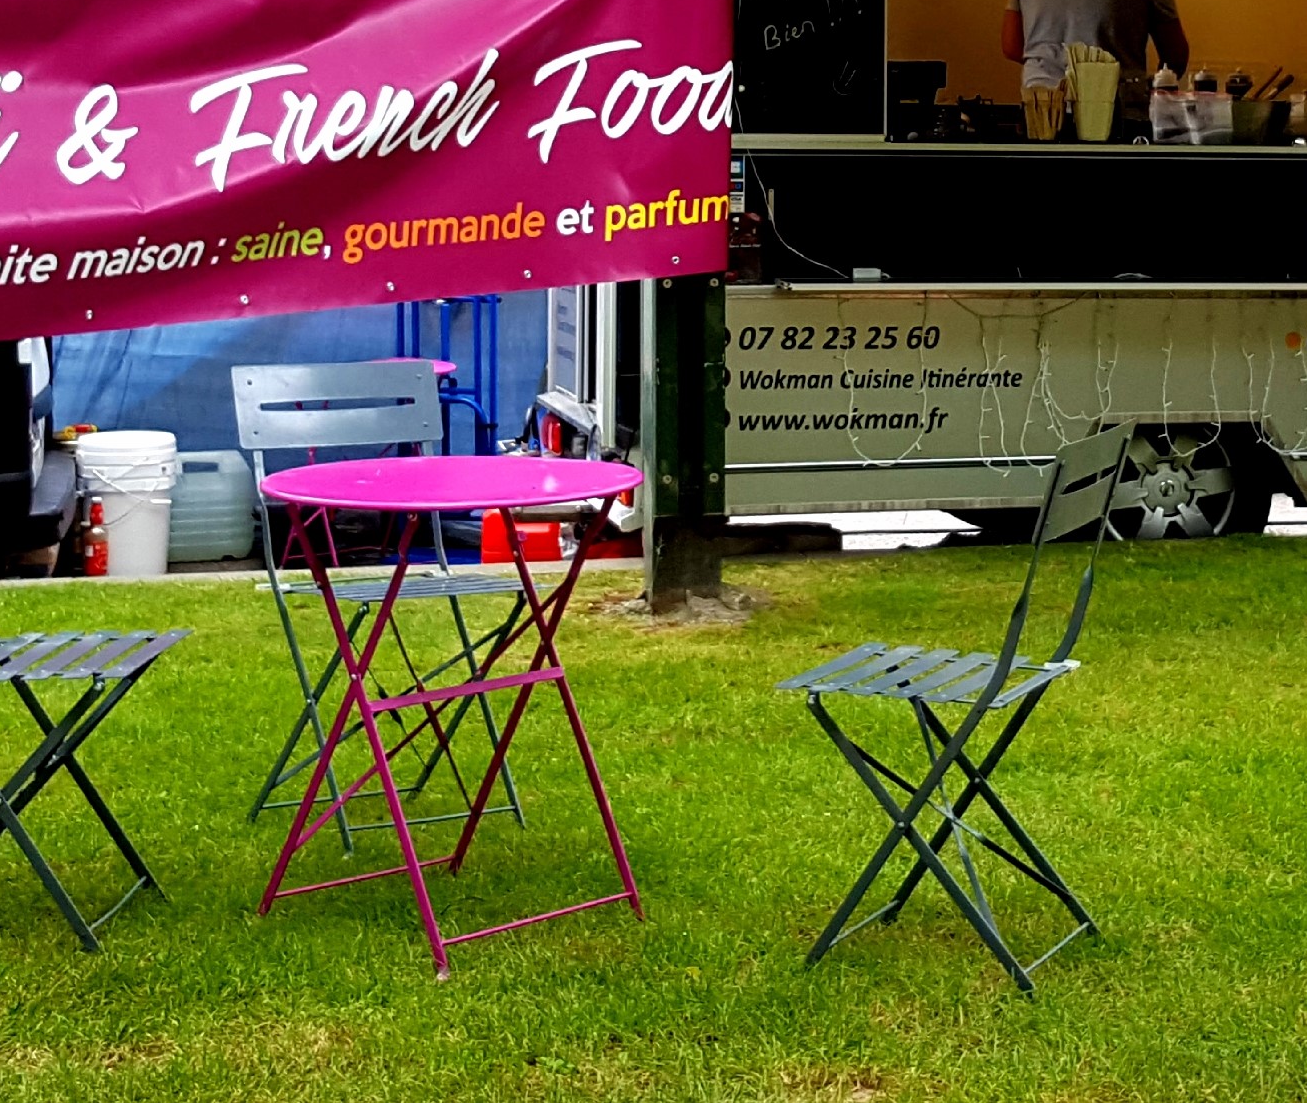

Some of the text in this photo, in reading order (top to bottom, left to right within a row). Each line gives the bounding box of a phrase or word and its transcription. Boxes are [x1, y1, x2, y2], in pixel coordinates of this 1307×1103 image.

[56, 84, 139, 186] &
[190, 48, 500, 193] French
[79, 239, 204, 280] maison
[231, 221, 332, 264] saine,
[342, 202, 546, 265] gourmande
[555, 201, 595, 235] et
[738, 325, 941, 350] 07 82 23 25 60
[739, 367, 1023, 390] Wokman Cuisine Itinérante
[738, 407, 949, 434] www.wokman.fr
